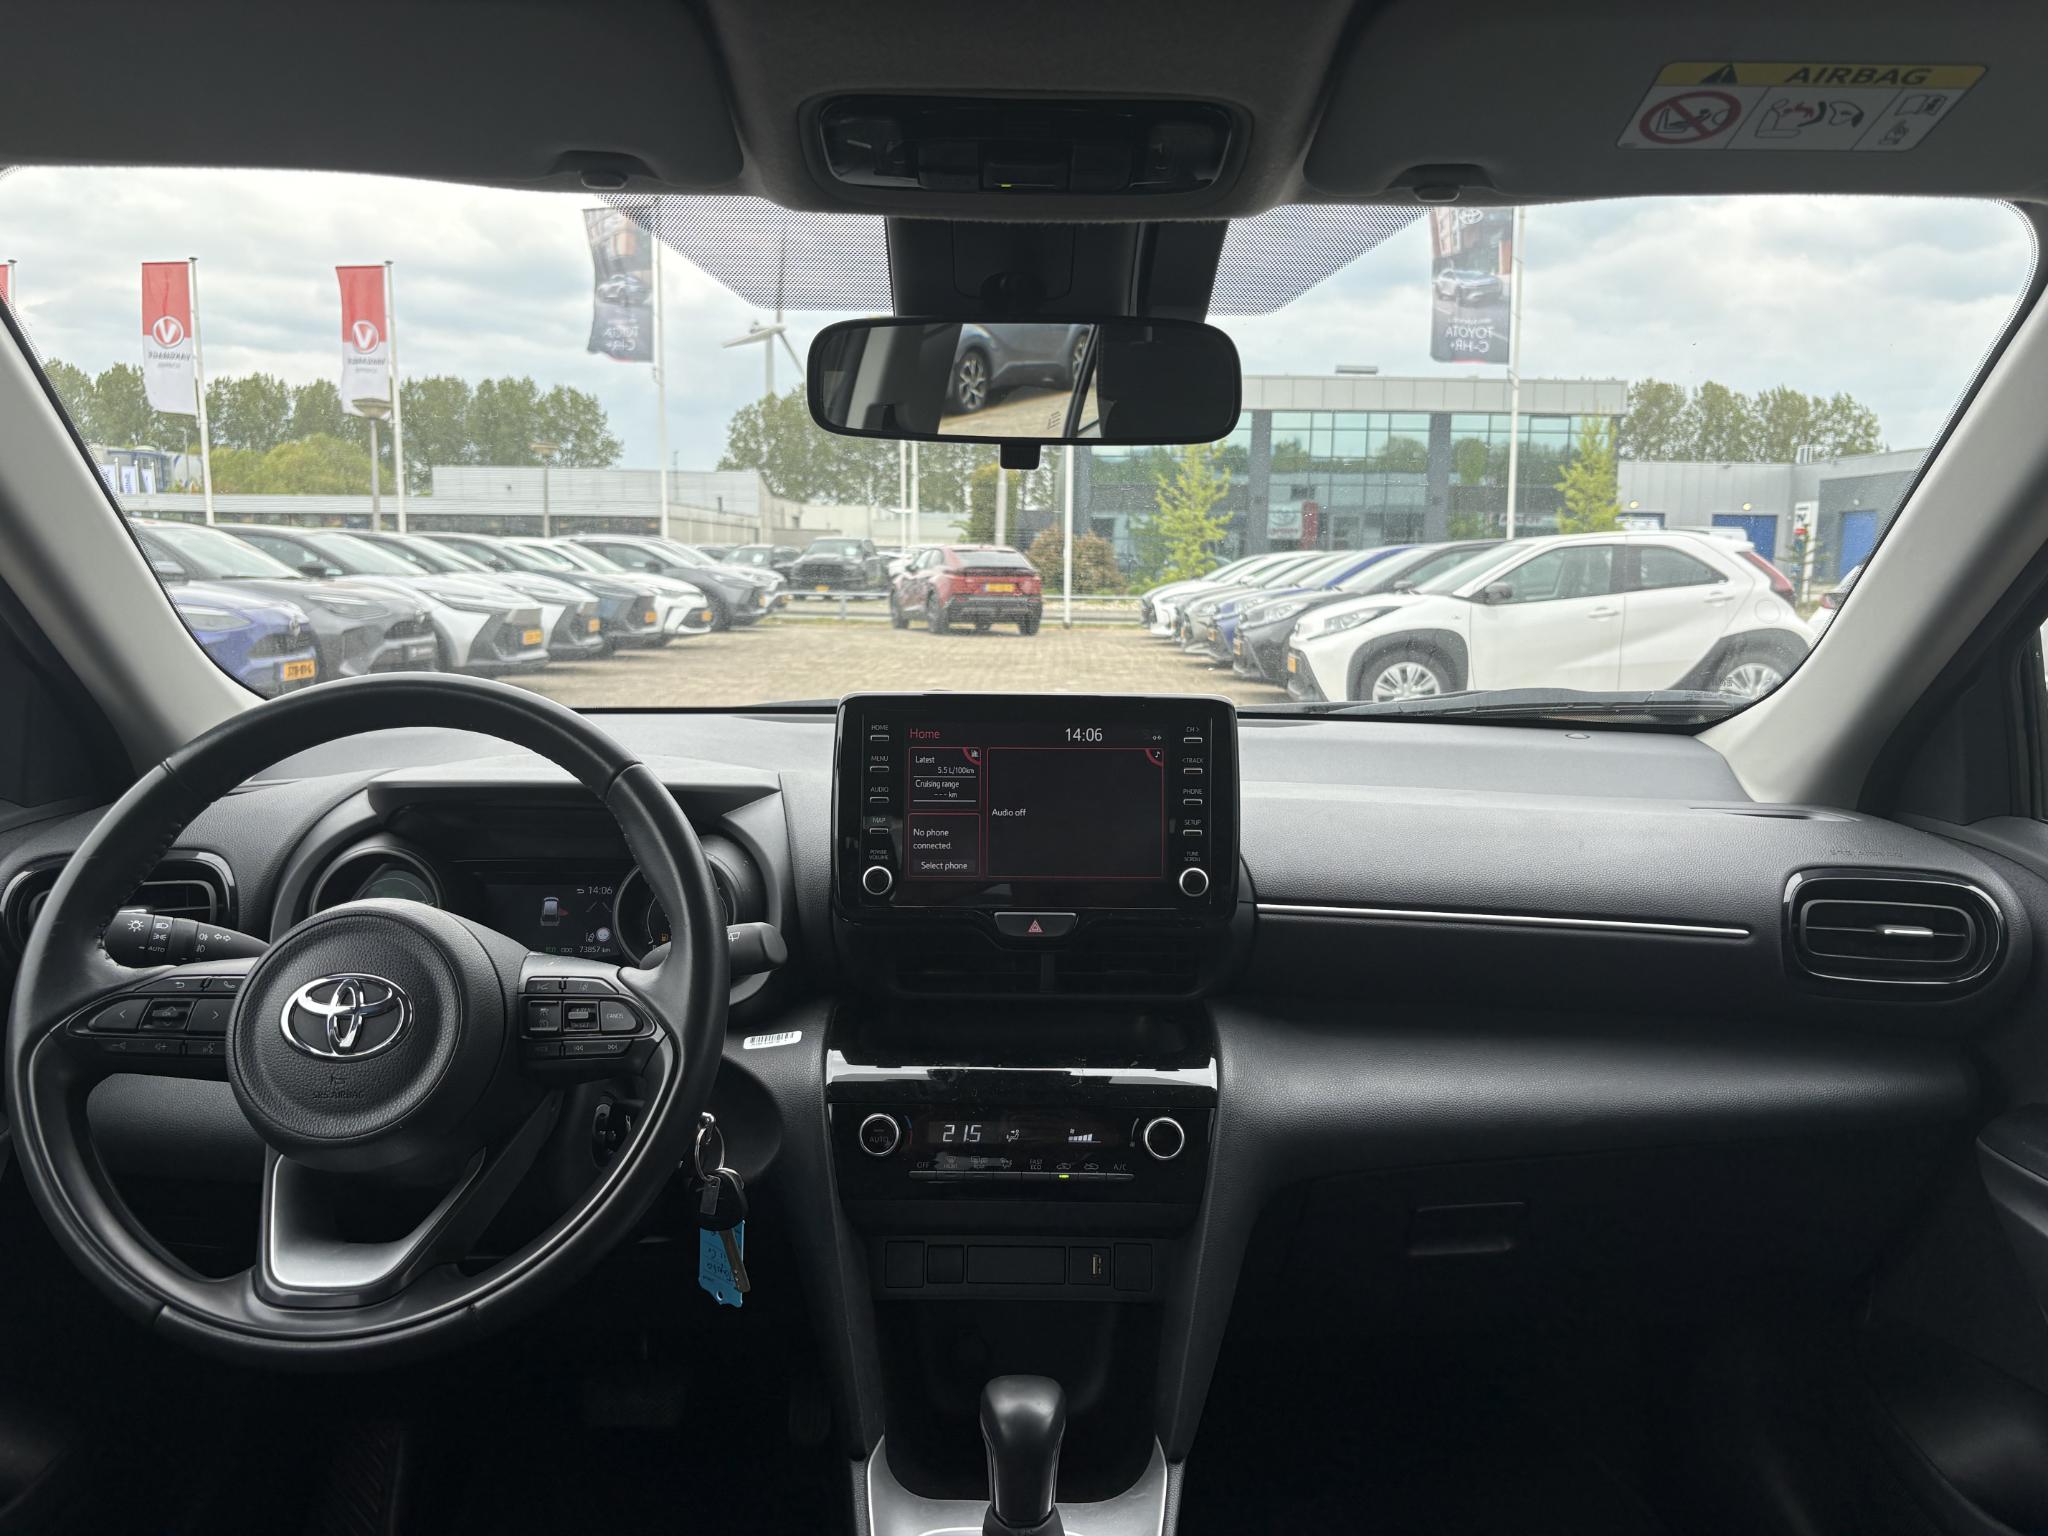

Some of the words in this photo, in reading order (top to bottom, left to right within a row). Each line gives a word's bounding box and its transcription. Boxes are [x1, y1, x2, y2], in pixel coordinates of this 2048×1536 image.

[1783, 67, 1933, 86] AIRBAG
[909, 728, 941, 739] Home
[1065, 727, 1103, 742] 14:06
[915, 755, 935, 764] Latest
[937, 766, 948, 774] 5.5
[948, 766, 975, 775] L/100km
[915, 779, 940, 790] Cruising
[941, 781, 960, 790] range
[992, 808, 1013, 817] Audio
[1014, 808, 1027, 817] off
[913, 828, 924, 836] No
[926, 828, 949, 838] phone
[913, 842, 952, 850] connected.
[920, 860, 943, 870] Select
[944, 861, 968, 871] phone
[588, 886, 612, 895] 14:06
[148, 945, 165, 953] AUTO
[579, 945, 601, 953] 73857
